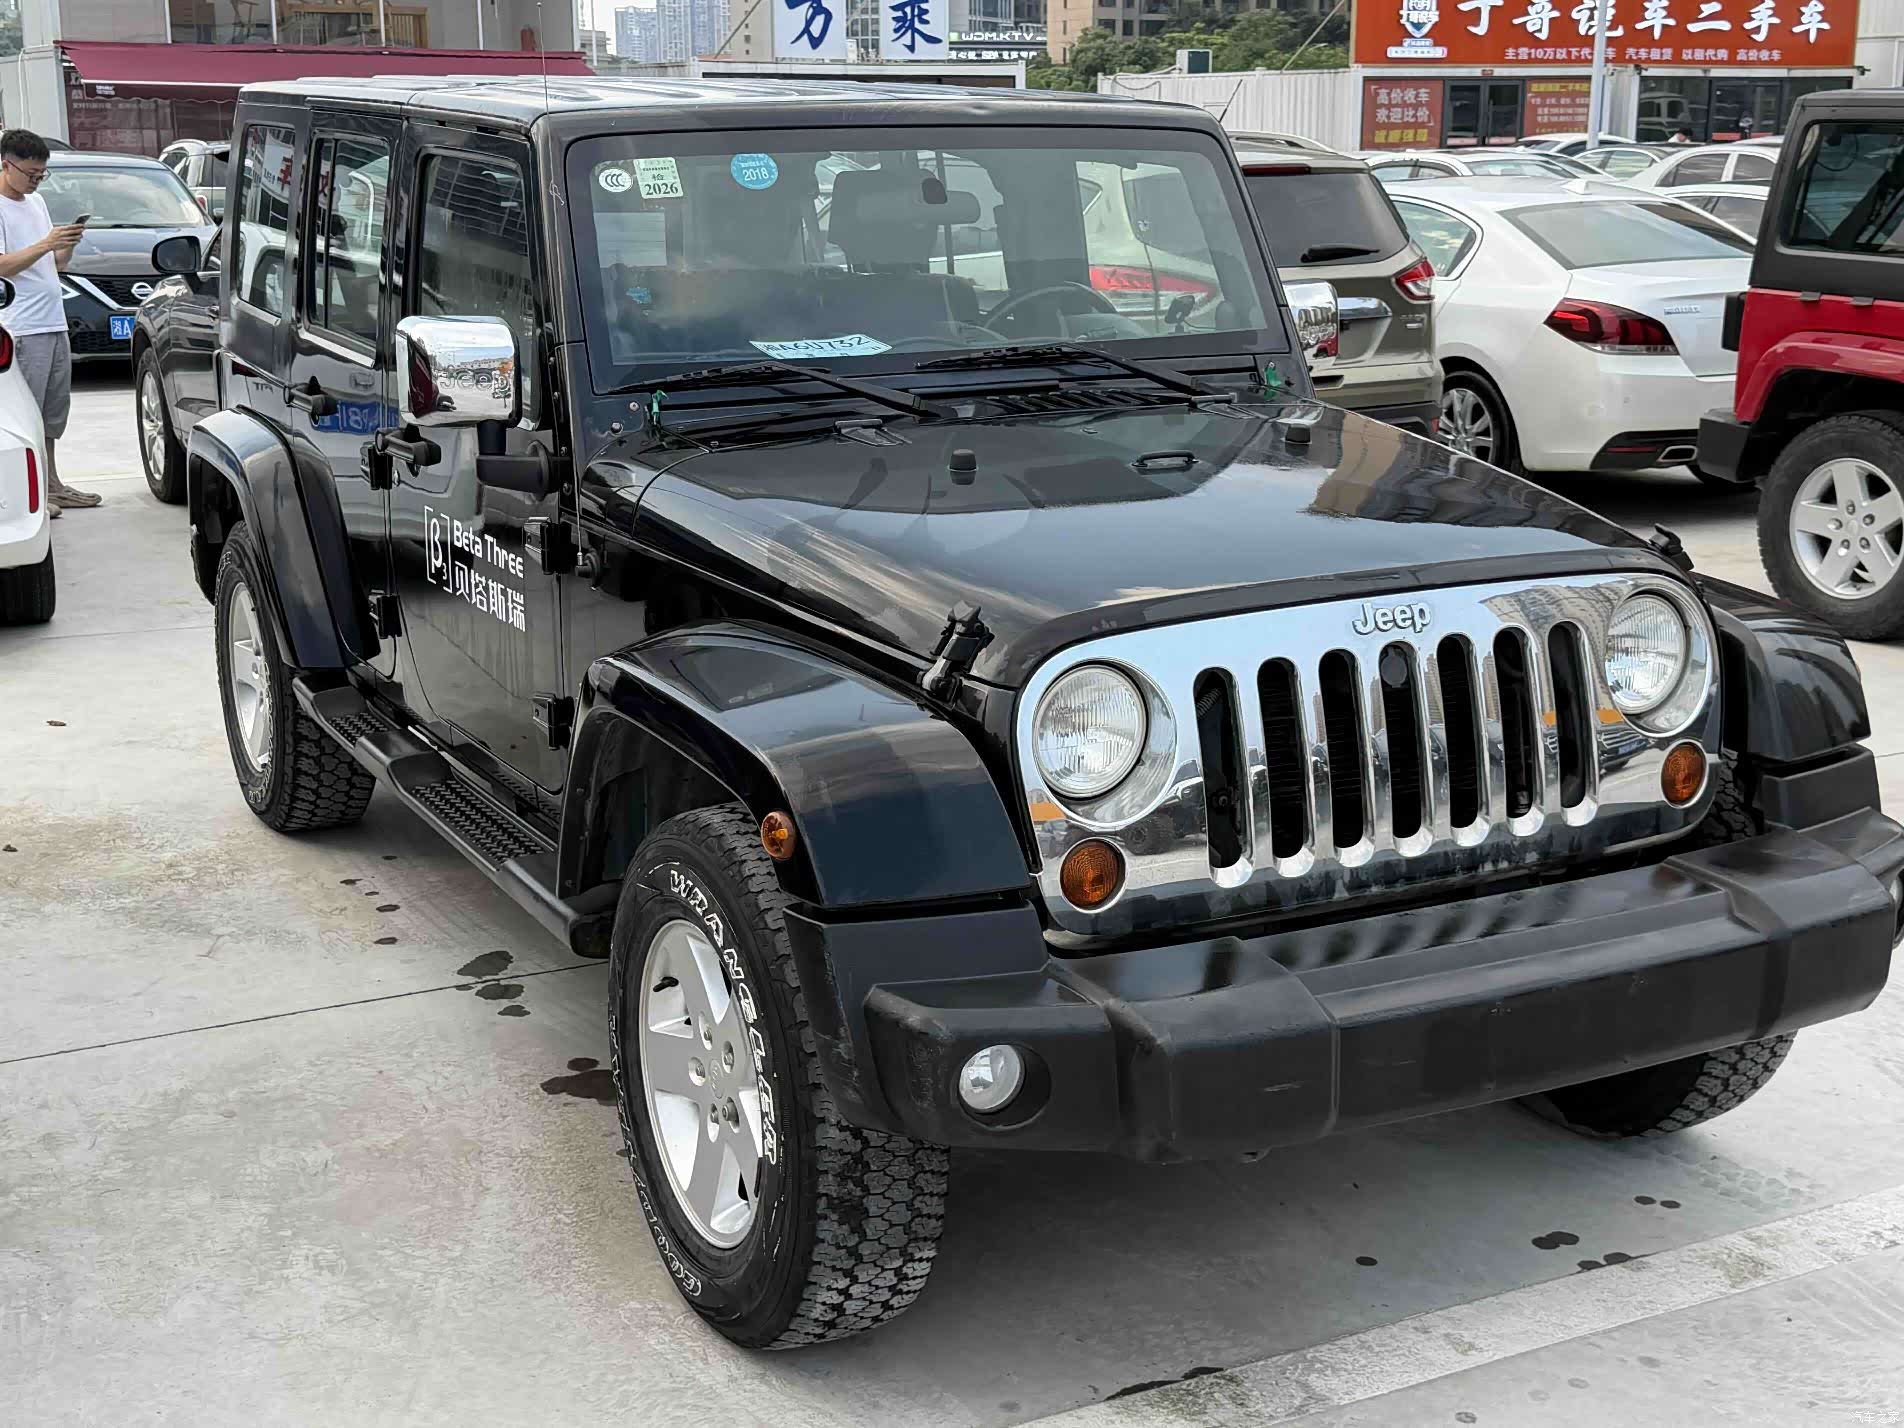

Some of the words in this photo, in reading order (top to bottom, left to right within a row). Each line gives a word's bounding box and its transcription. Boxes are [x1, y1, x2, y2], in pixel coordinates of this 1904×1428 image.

[1504, 47, 1617, 60] 主营10万以下代车
[742, 167, 769, 181] 2018
[645, 182, 678, 196] 2026
[453, 519, 483, 558] Beta
[484, 533, 524, 579] Three
[454, 560, 526, 633] 贝塔斯瑞
[1351, 601, 1432, 636] Jeep
